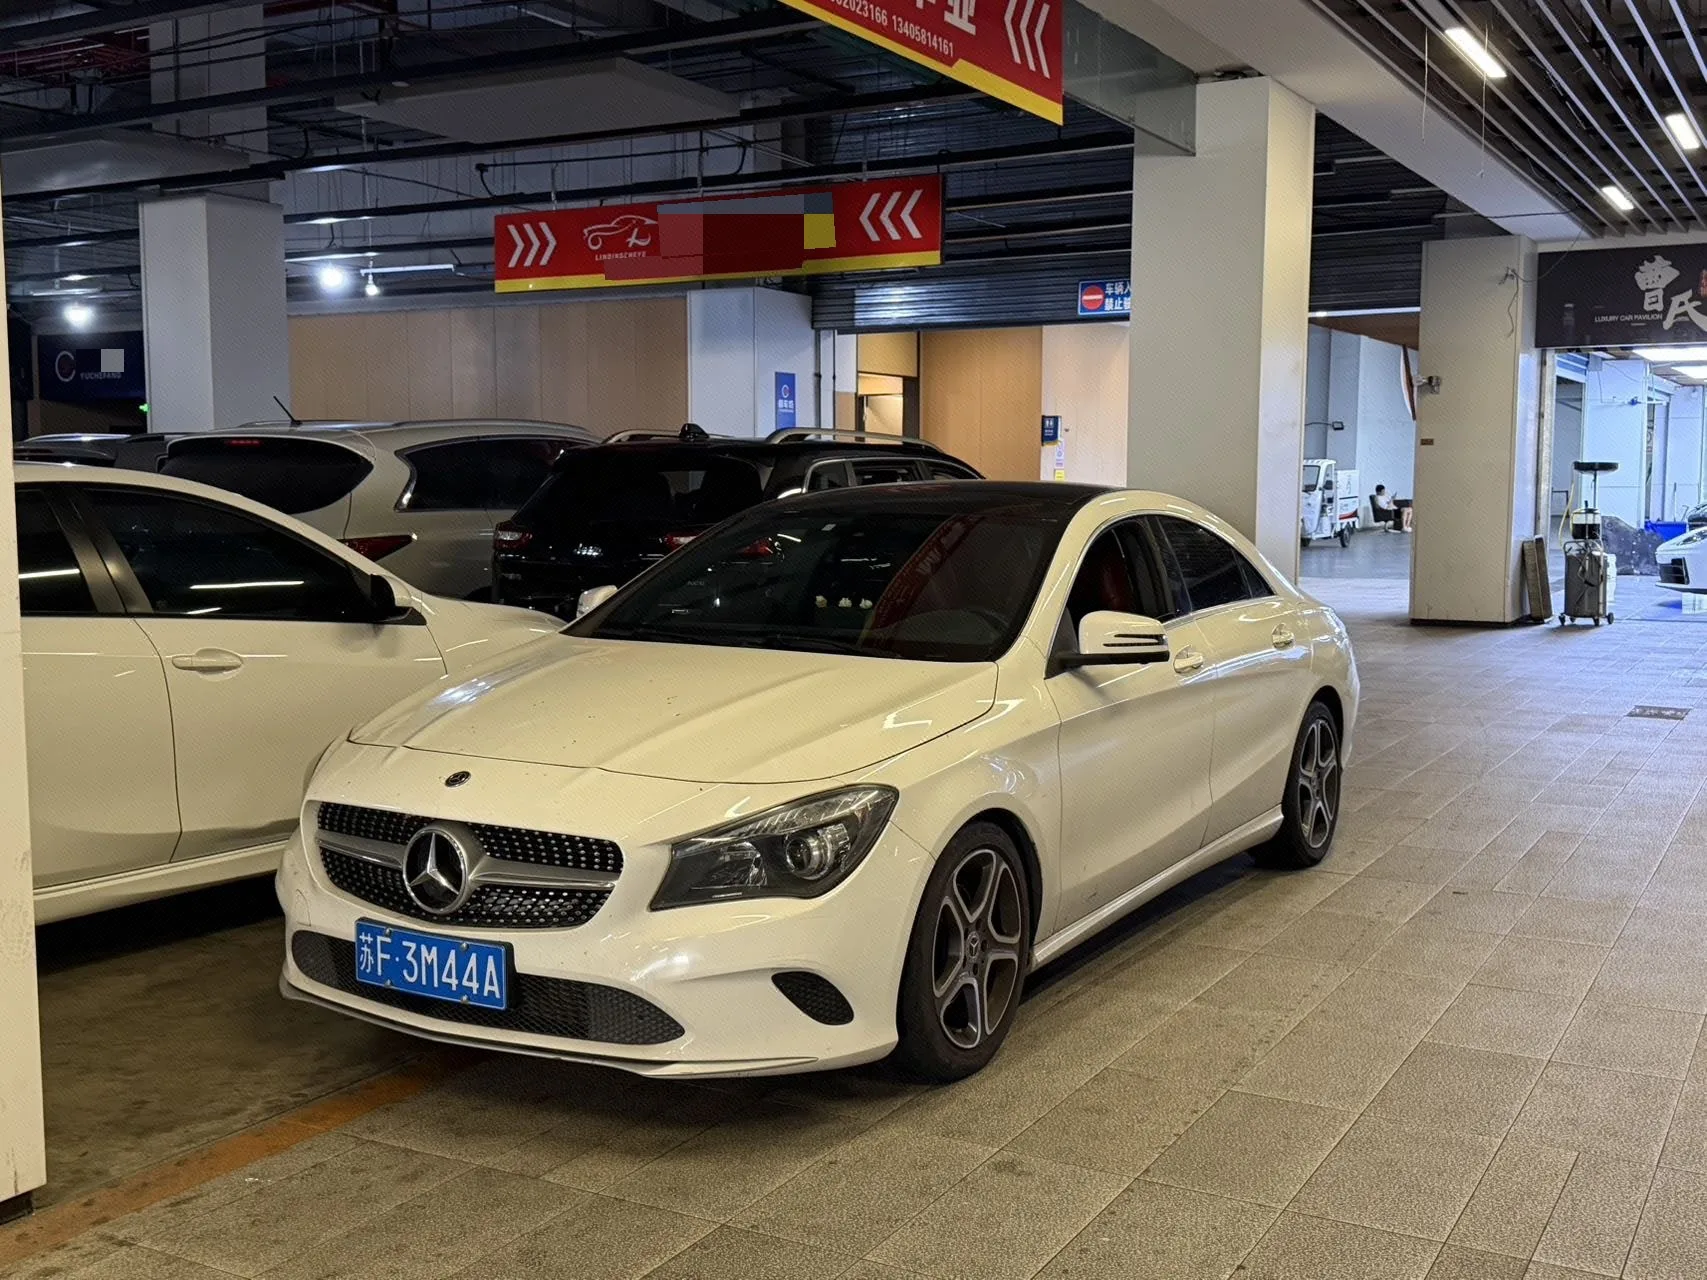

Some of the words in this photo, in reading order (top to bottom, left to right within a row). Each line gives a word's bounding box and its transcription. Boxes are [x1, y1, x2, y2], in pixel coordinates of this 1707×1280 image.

[892, 15, 954, 57] 13405814161
[1594, 315, 1619, 323] LUXURY
[1619, 314, 1634, 322] CAR
[1634, 313, 1663, 321] PAVILION
[359, 932, 501, 999] 苏F·3M44A
